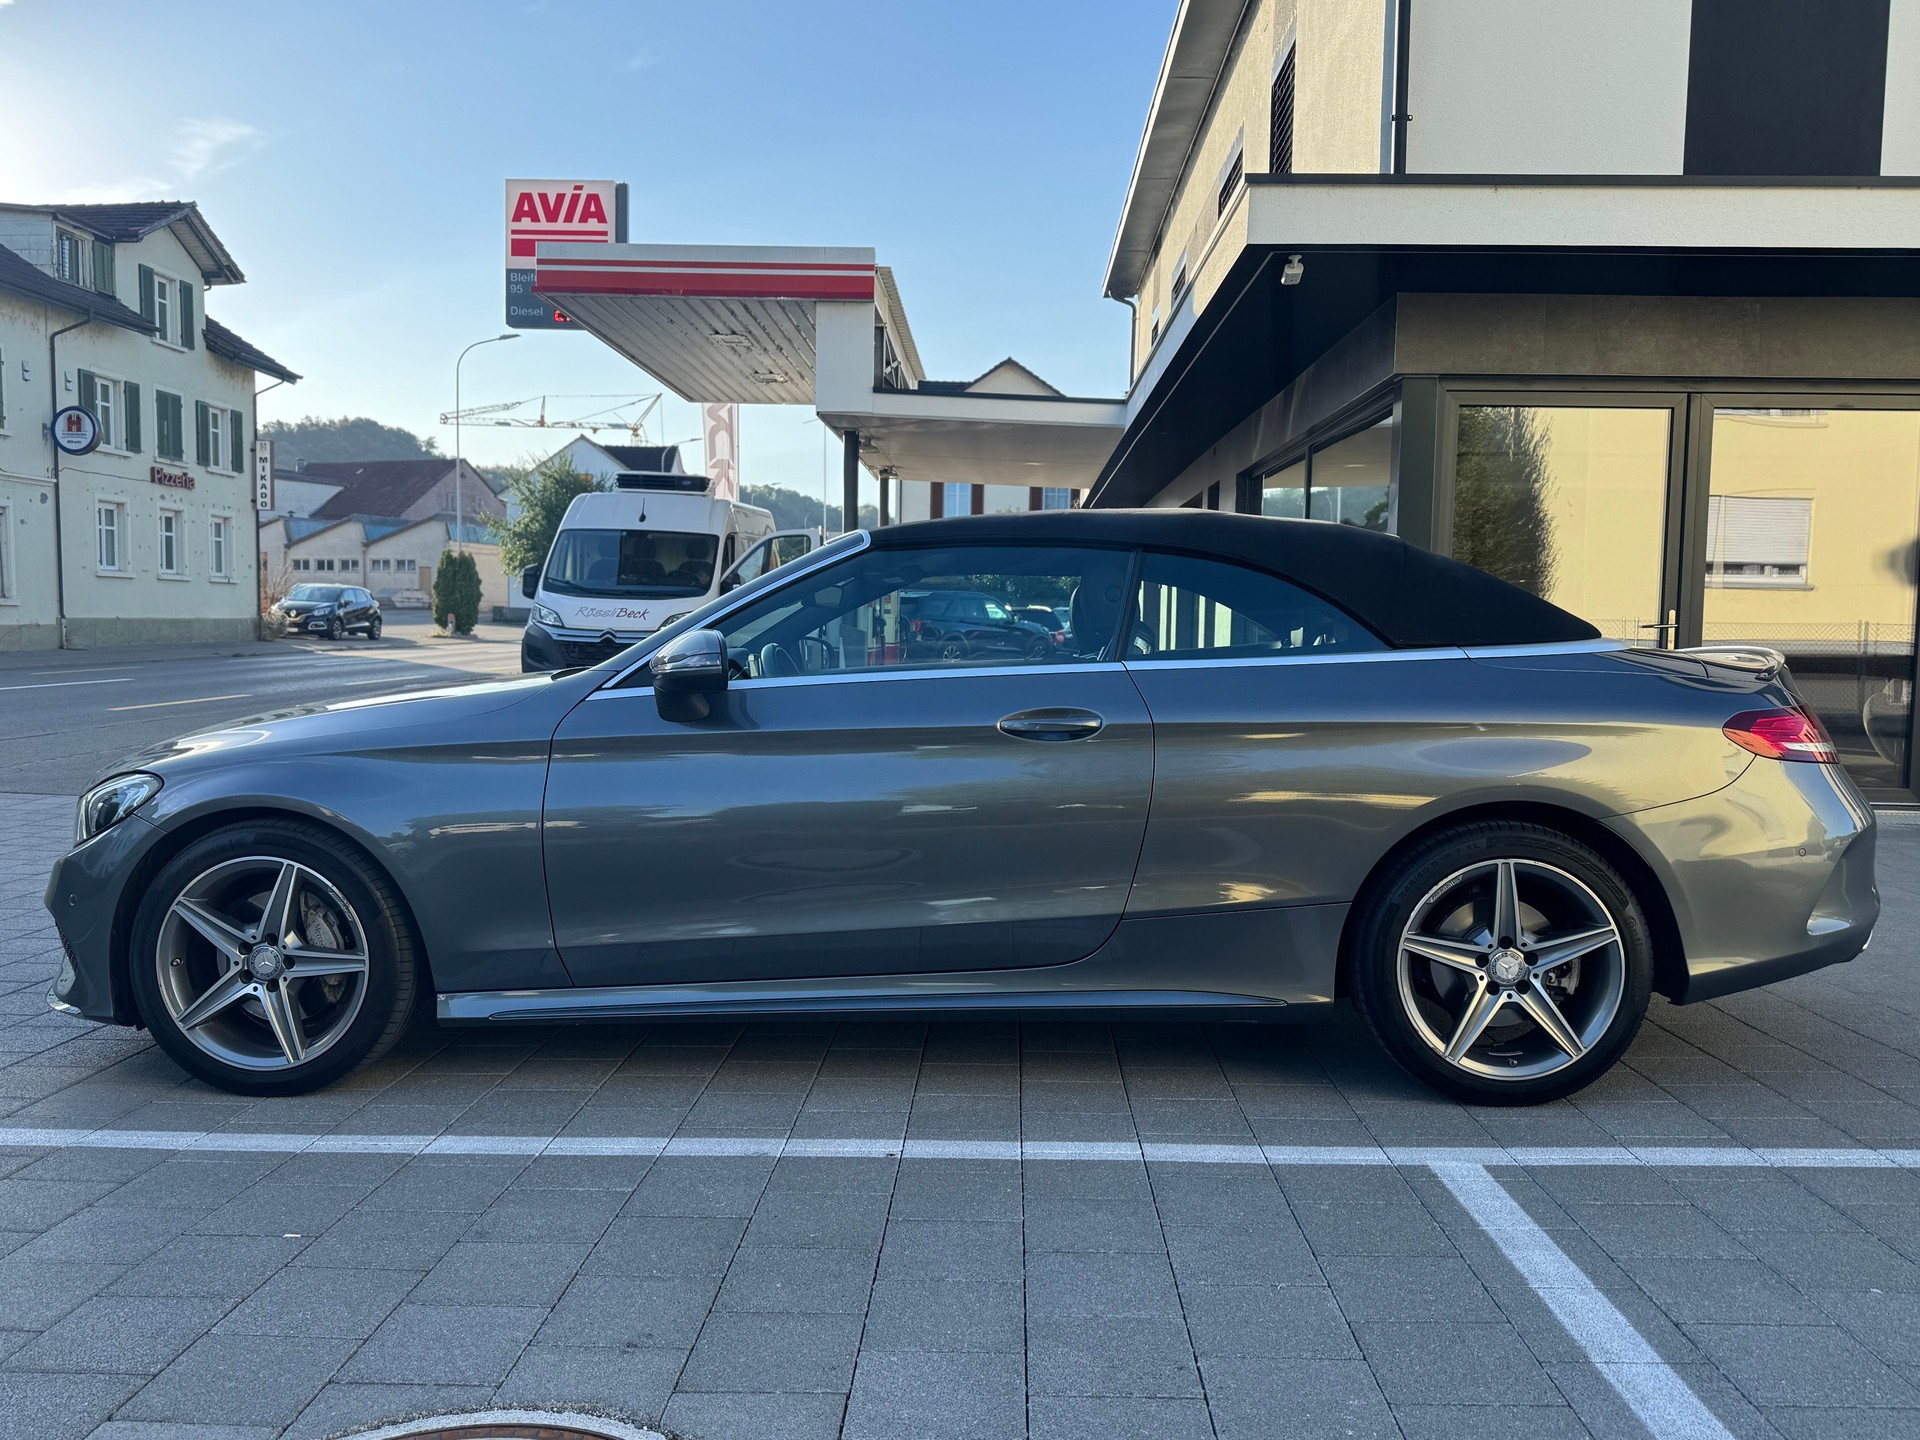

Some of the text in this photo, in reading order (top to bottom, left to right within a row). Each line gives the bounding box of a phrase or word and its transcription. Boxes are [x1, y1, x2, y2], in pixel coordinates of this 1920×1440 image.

[510, 284, 523, 294] 95
[510, 306, 543, 316] Diesel
[153, 467, 195, 489] Pizzeria
[259, 456, 268, 508] MIKADO
